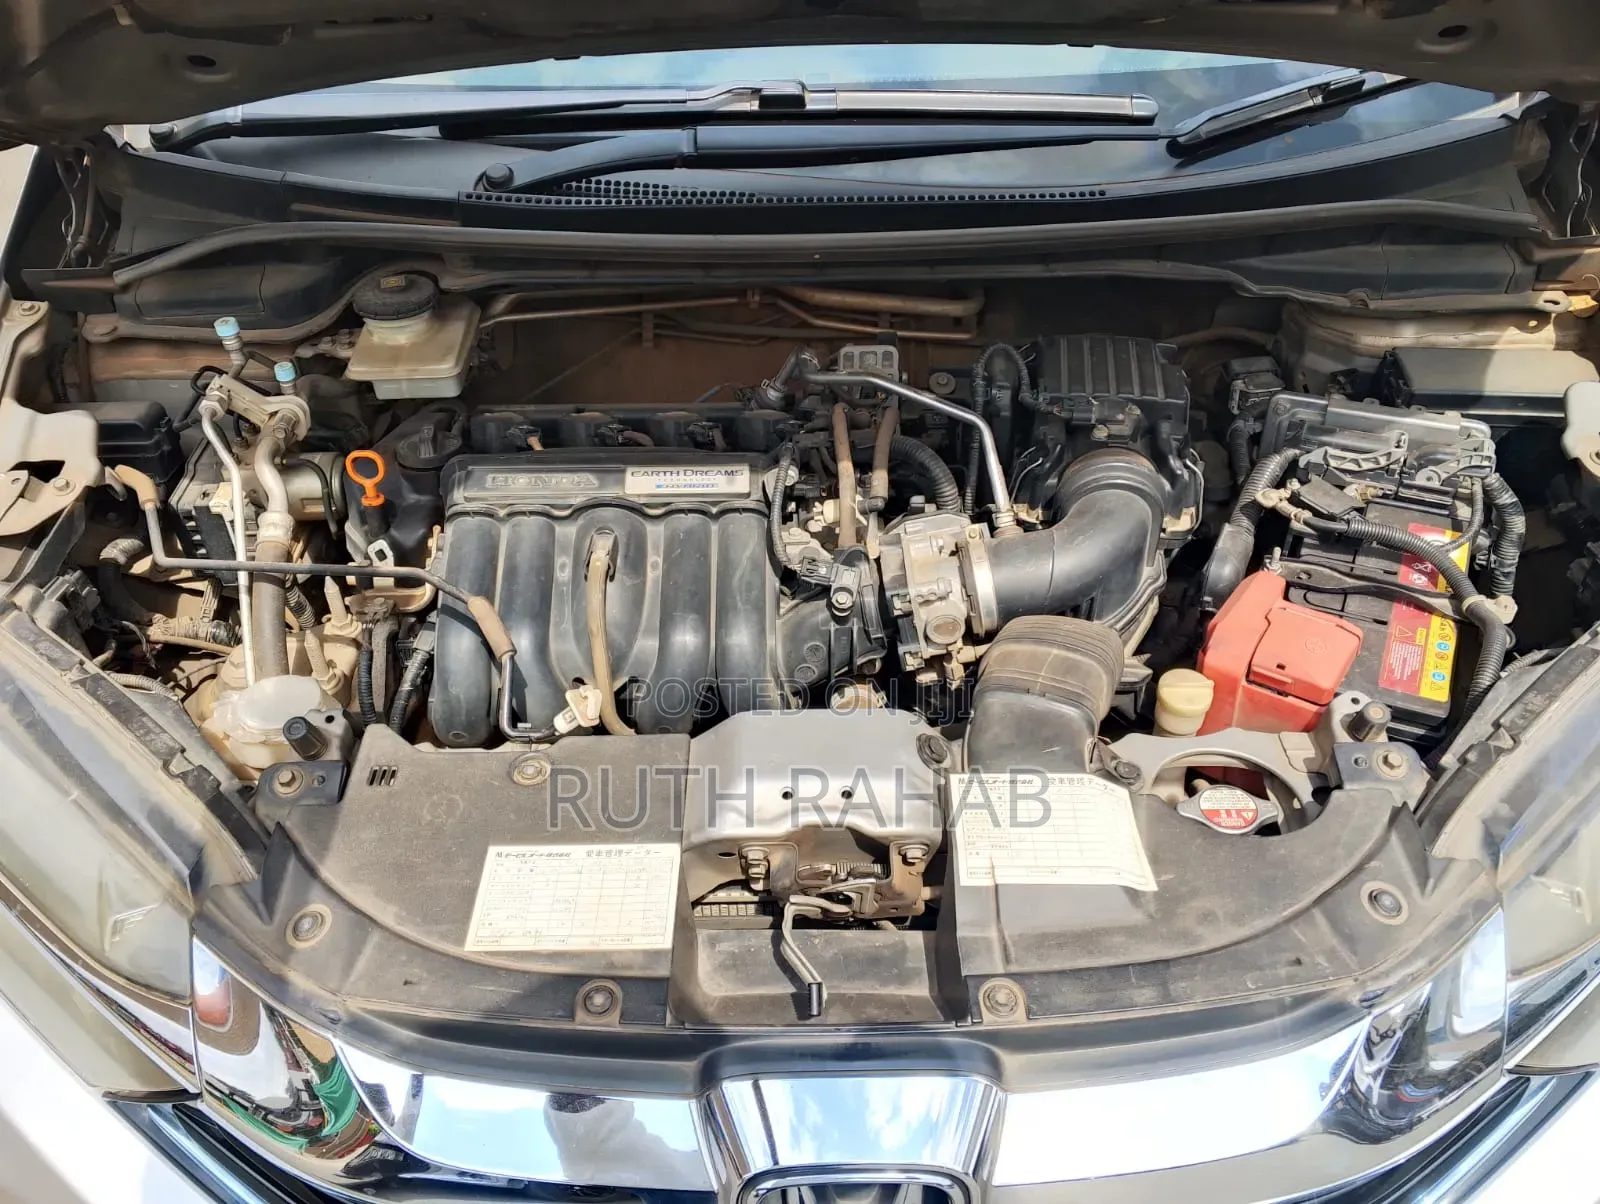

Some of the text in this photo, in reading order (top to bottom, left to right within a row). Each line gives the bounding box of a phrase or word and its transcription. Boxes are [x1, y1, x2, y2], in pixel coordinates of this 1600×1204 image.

[631, 468, 744, 477] EARTH DREAMS
[486, 473, 599, 488] HONDA
